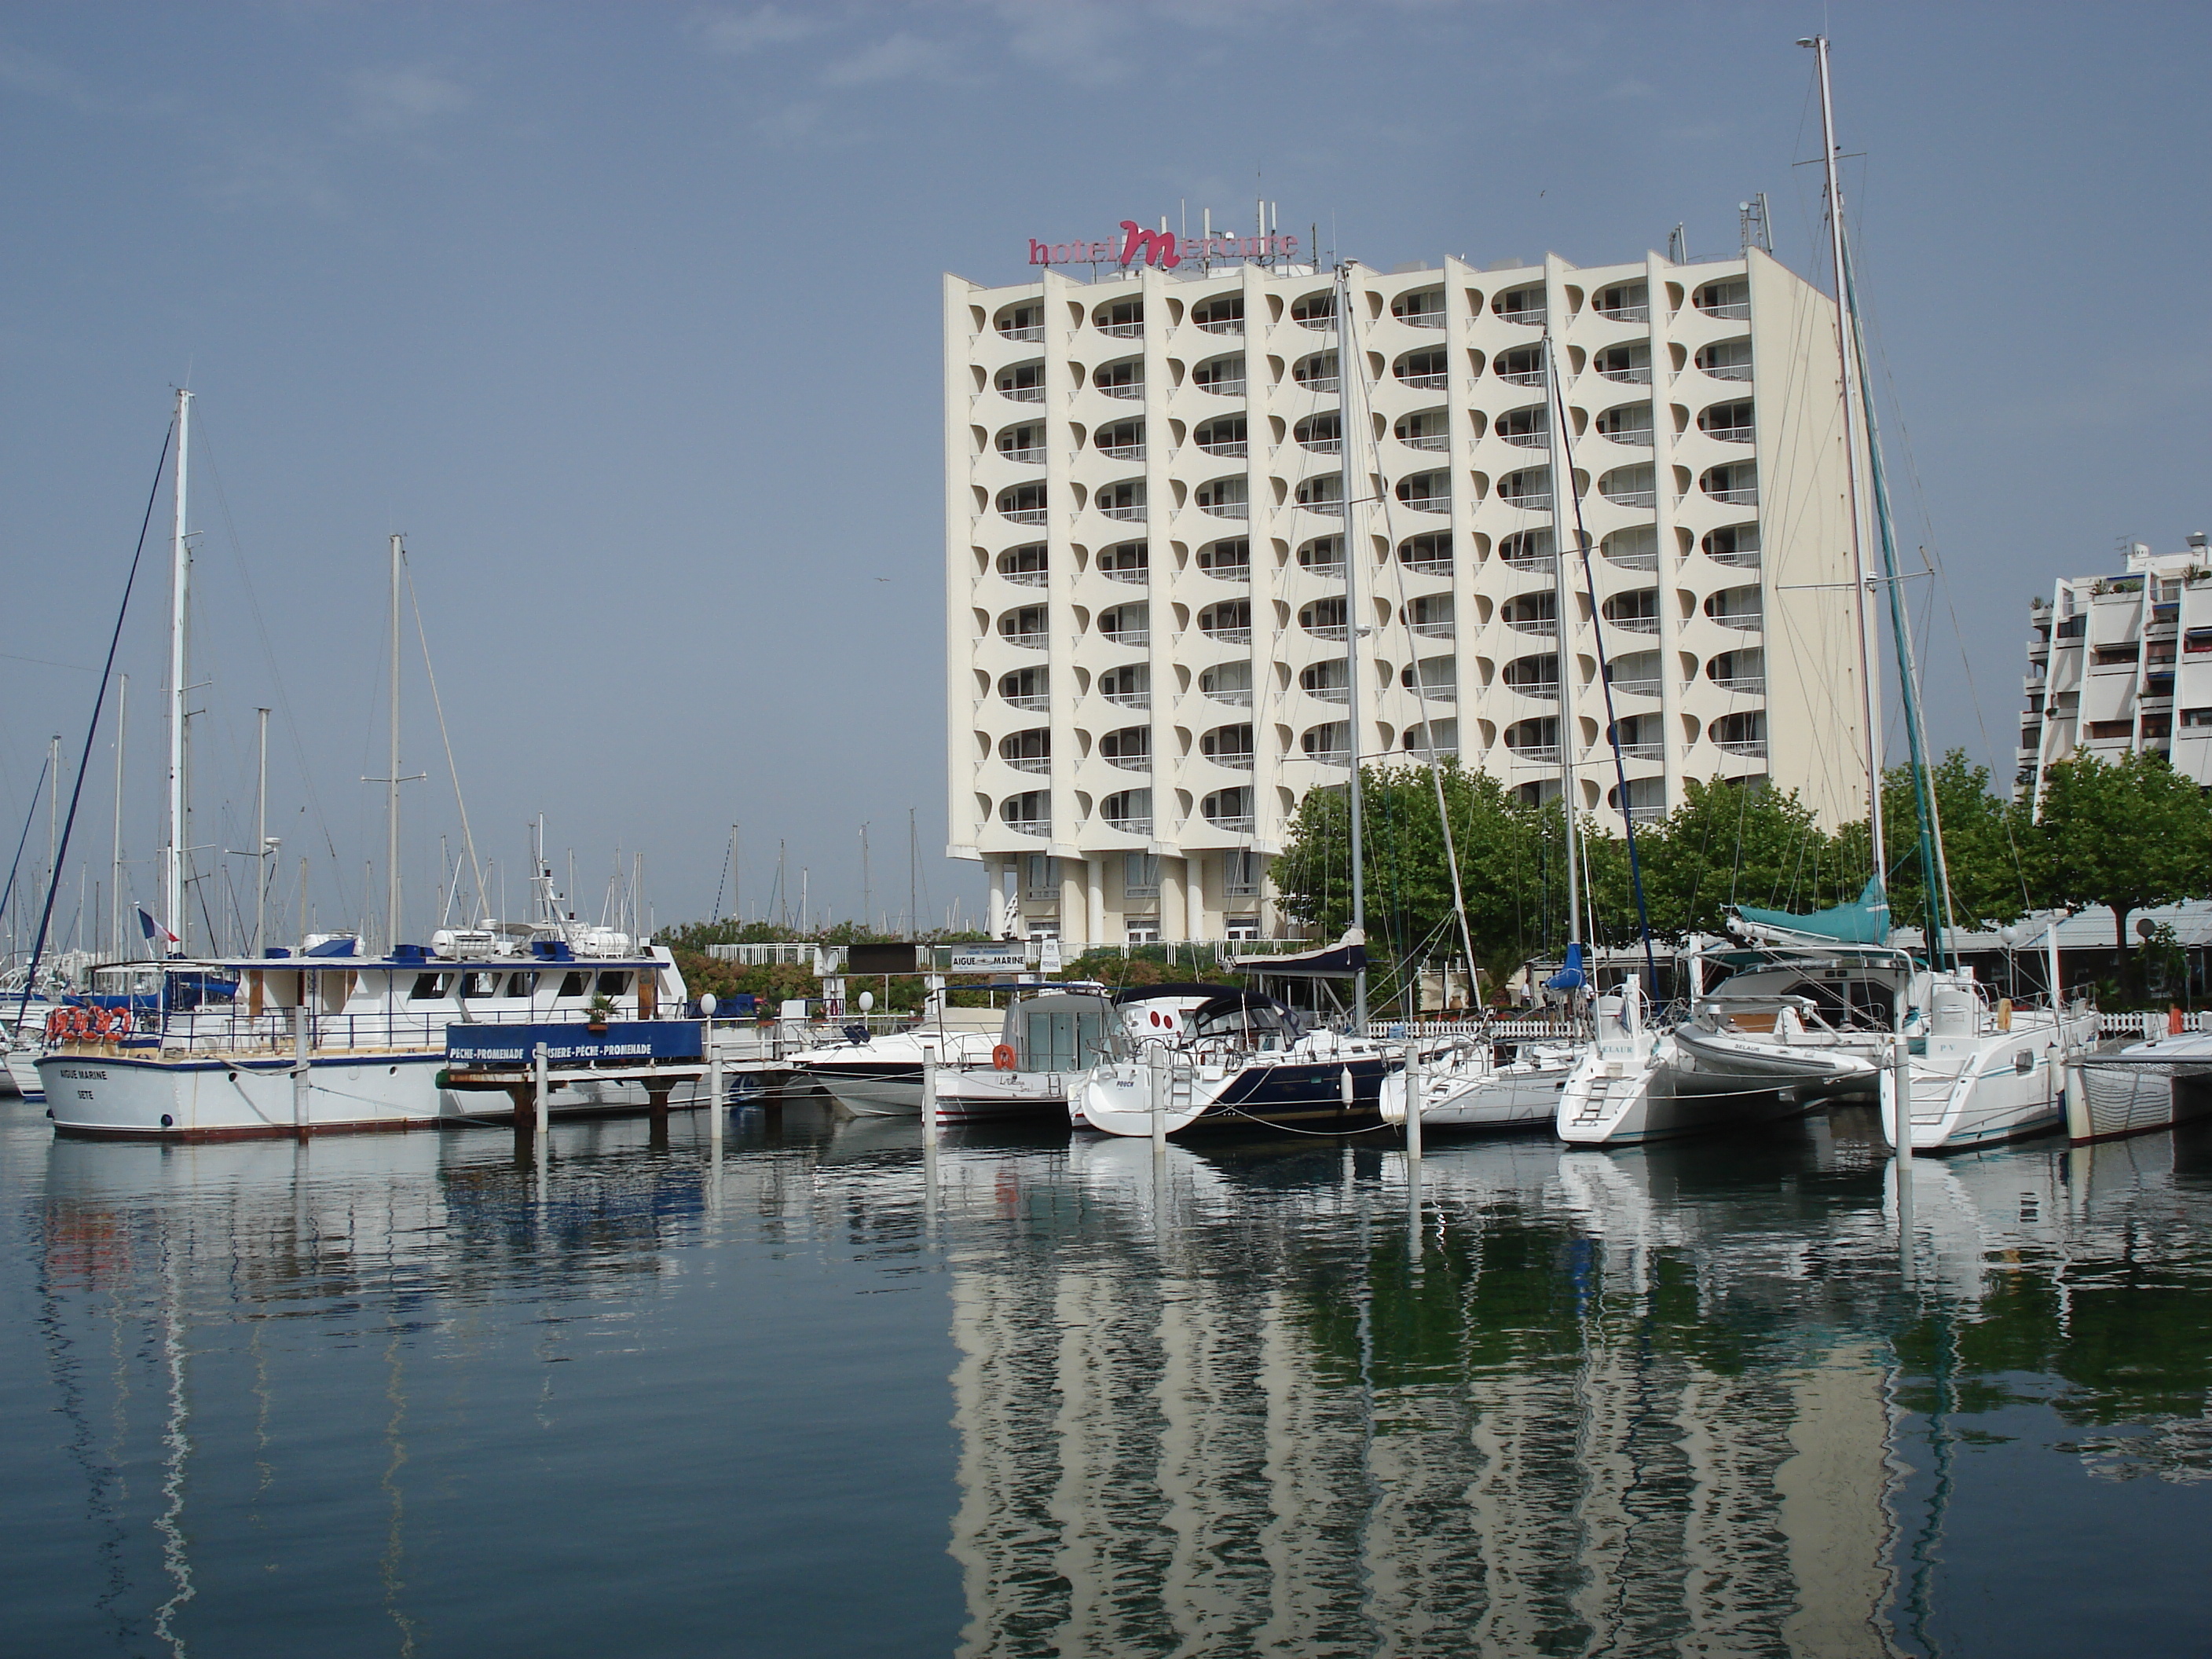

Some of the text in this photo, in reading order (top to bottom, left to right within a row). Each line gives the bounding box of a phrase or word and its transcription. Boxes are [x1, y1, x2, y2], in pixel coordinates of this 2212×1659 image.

[1028, 236, 1117, 264] hotel
[953, 956, 1024, 965] AIGUE MARINE
[60, 1069, 108, 1080] AIGUE MARINE
[77, 1090, 94, 1100] SETE
